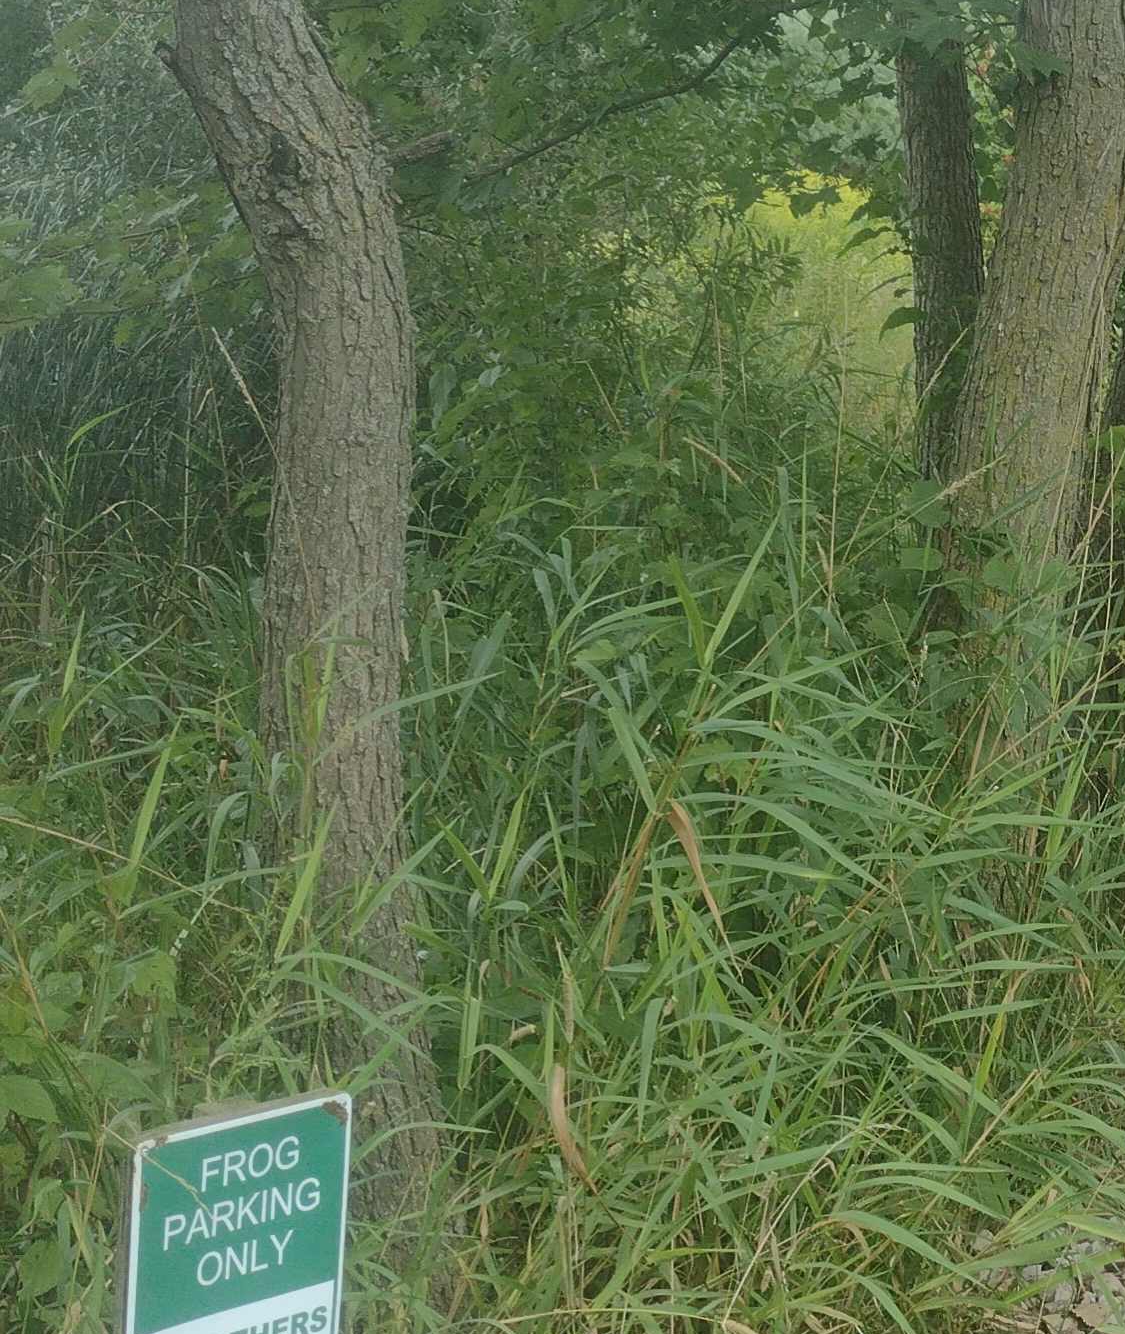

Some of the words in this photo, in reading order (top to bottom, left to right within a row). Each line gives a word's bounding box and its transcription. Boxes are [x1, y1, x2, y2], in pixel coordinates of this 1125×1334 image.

[201, 1136, 300, 1192] FROG
[163, 1177, 321, 1251] PARKING
[196, 1229, 294, 1286] ONLY
